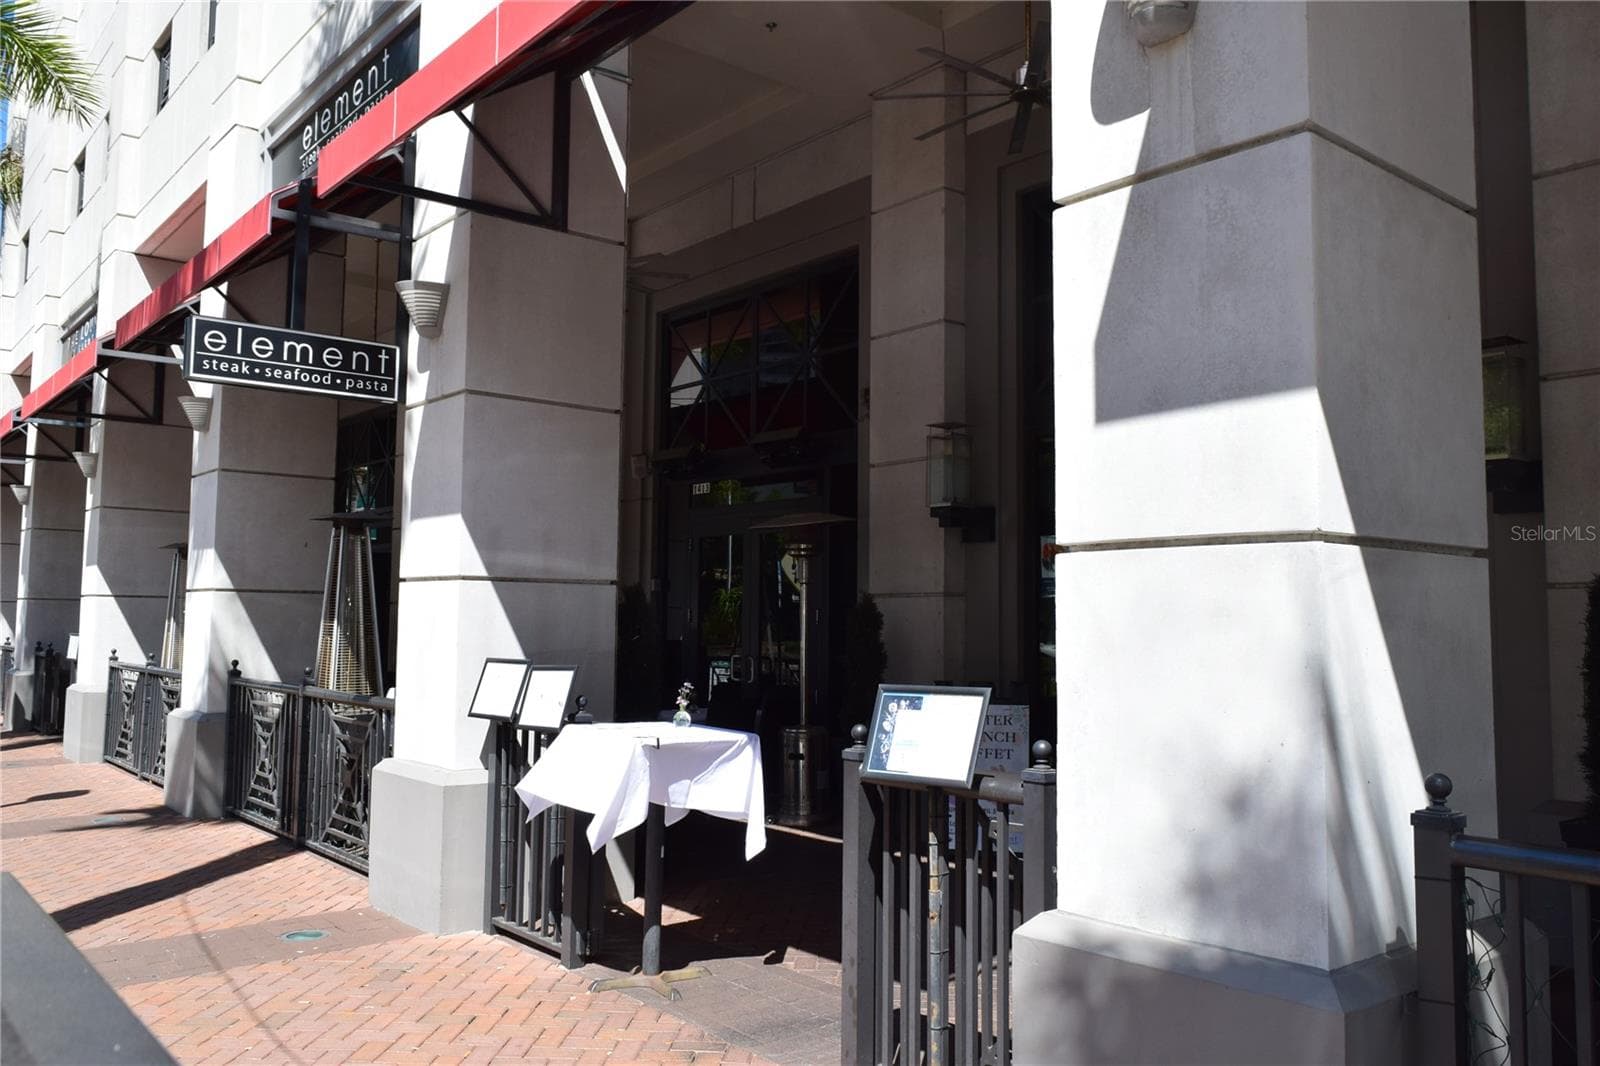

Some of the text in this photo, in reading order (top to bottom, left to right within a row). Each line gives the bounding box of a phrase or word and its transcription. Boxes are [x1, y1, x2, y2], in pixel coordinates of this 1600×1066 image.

[302, 48, 390, 151] element
[203, 327, 390, 374] element
[202, 358, 388, 392] steak seafood pasta
